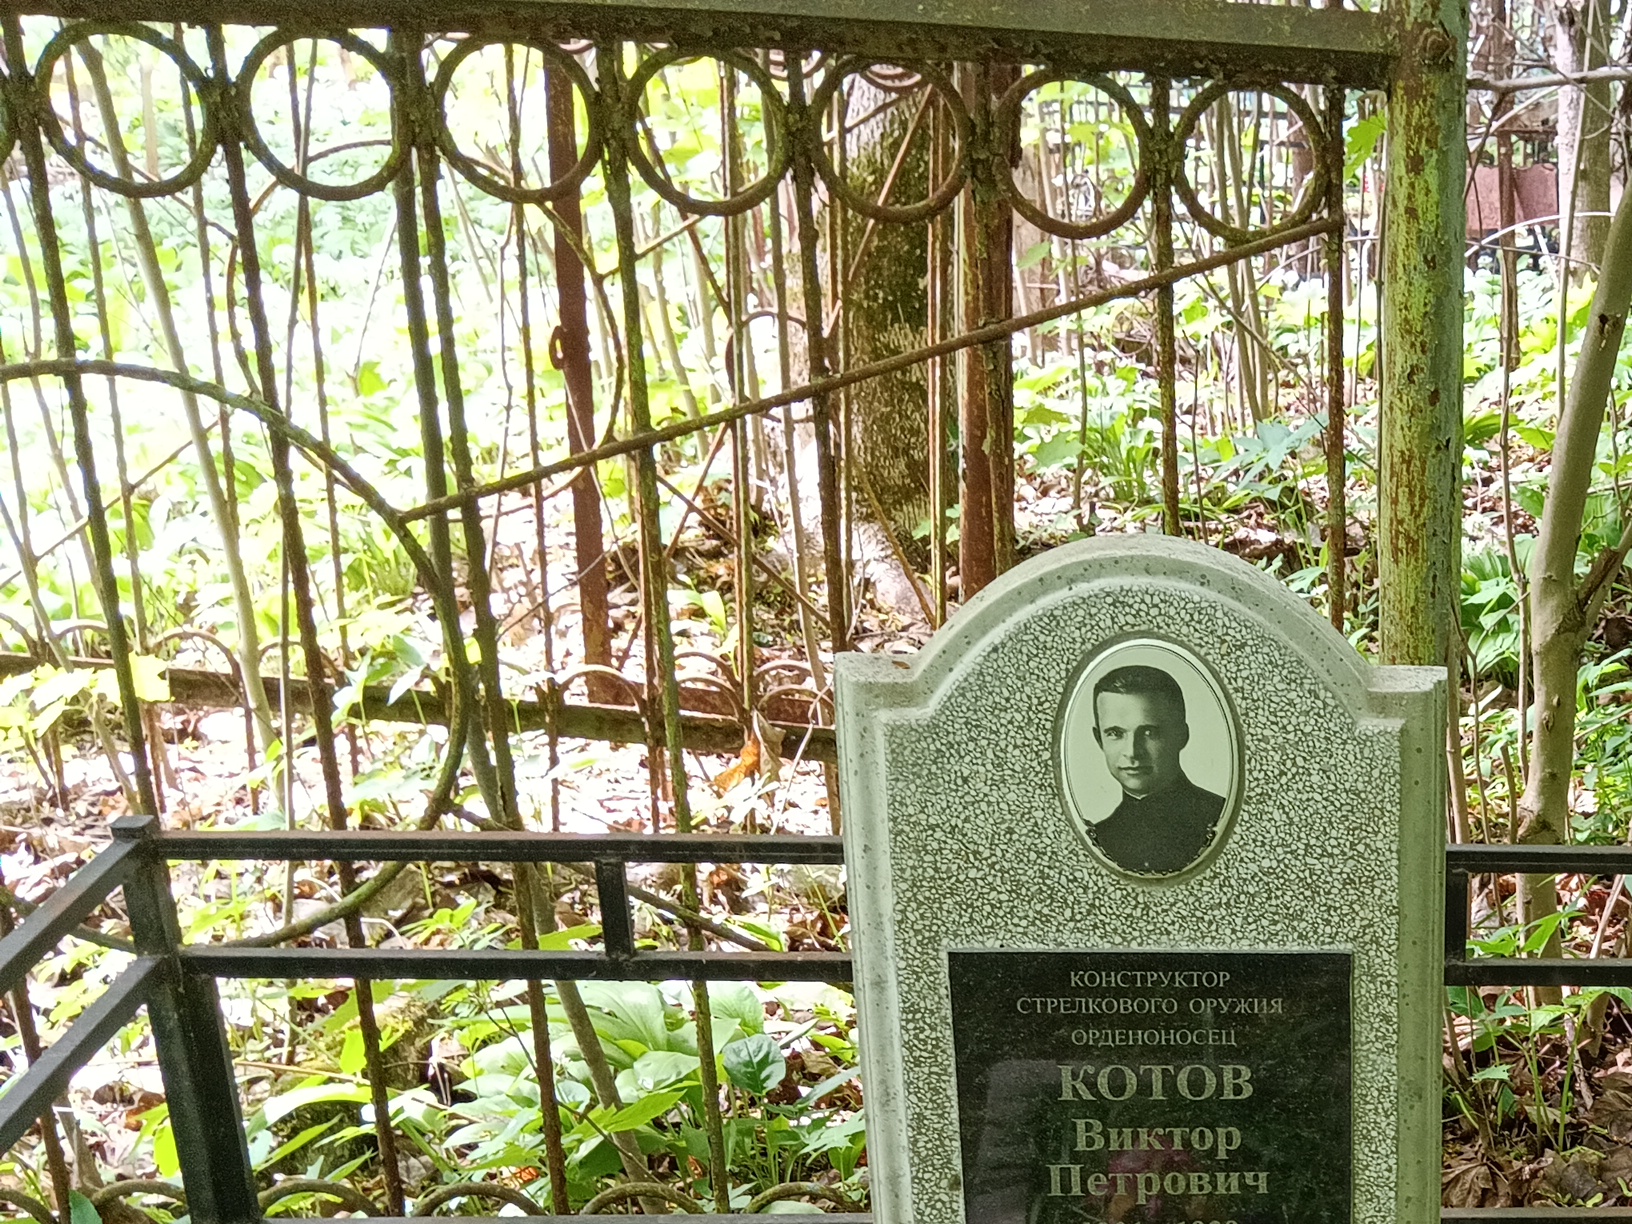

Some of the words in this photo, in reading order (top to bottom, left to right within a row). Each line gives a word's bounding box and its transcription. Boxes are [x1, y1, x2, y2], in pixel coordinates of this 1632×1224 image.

[1069, 970, 1232, 988] КОНСТРУКТОР
[1016, 997, 1179, 1015] СТРЕЛКОВОГО
[1188, 997, 1284, 1015] ОРУЖИЯ
[1070, 1028, 1238, 1048] ОРДЕНОНОСЕЦ
[1056, 1064, 1255, 1101] КОТОВ
[1071, 1118, 1243, 1160] Виктор
[1046, 1164, 1270, 1205] Петрович
